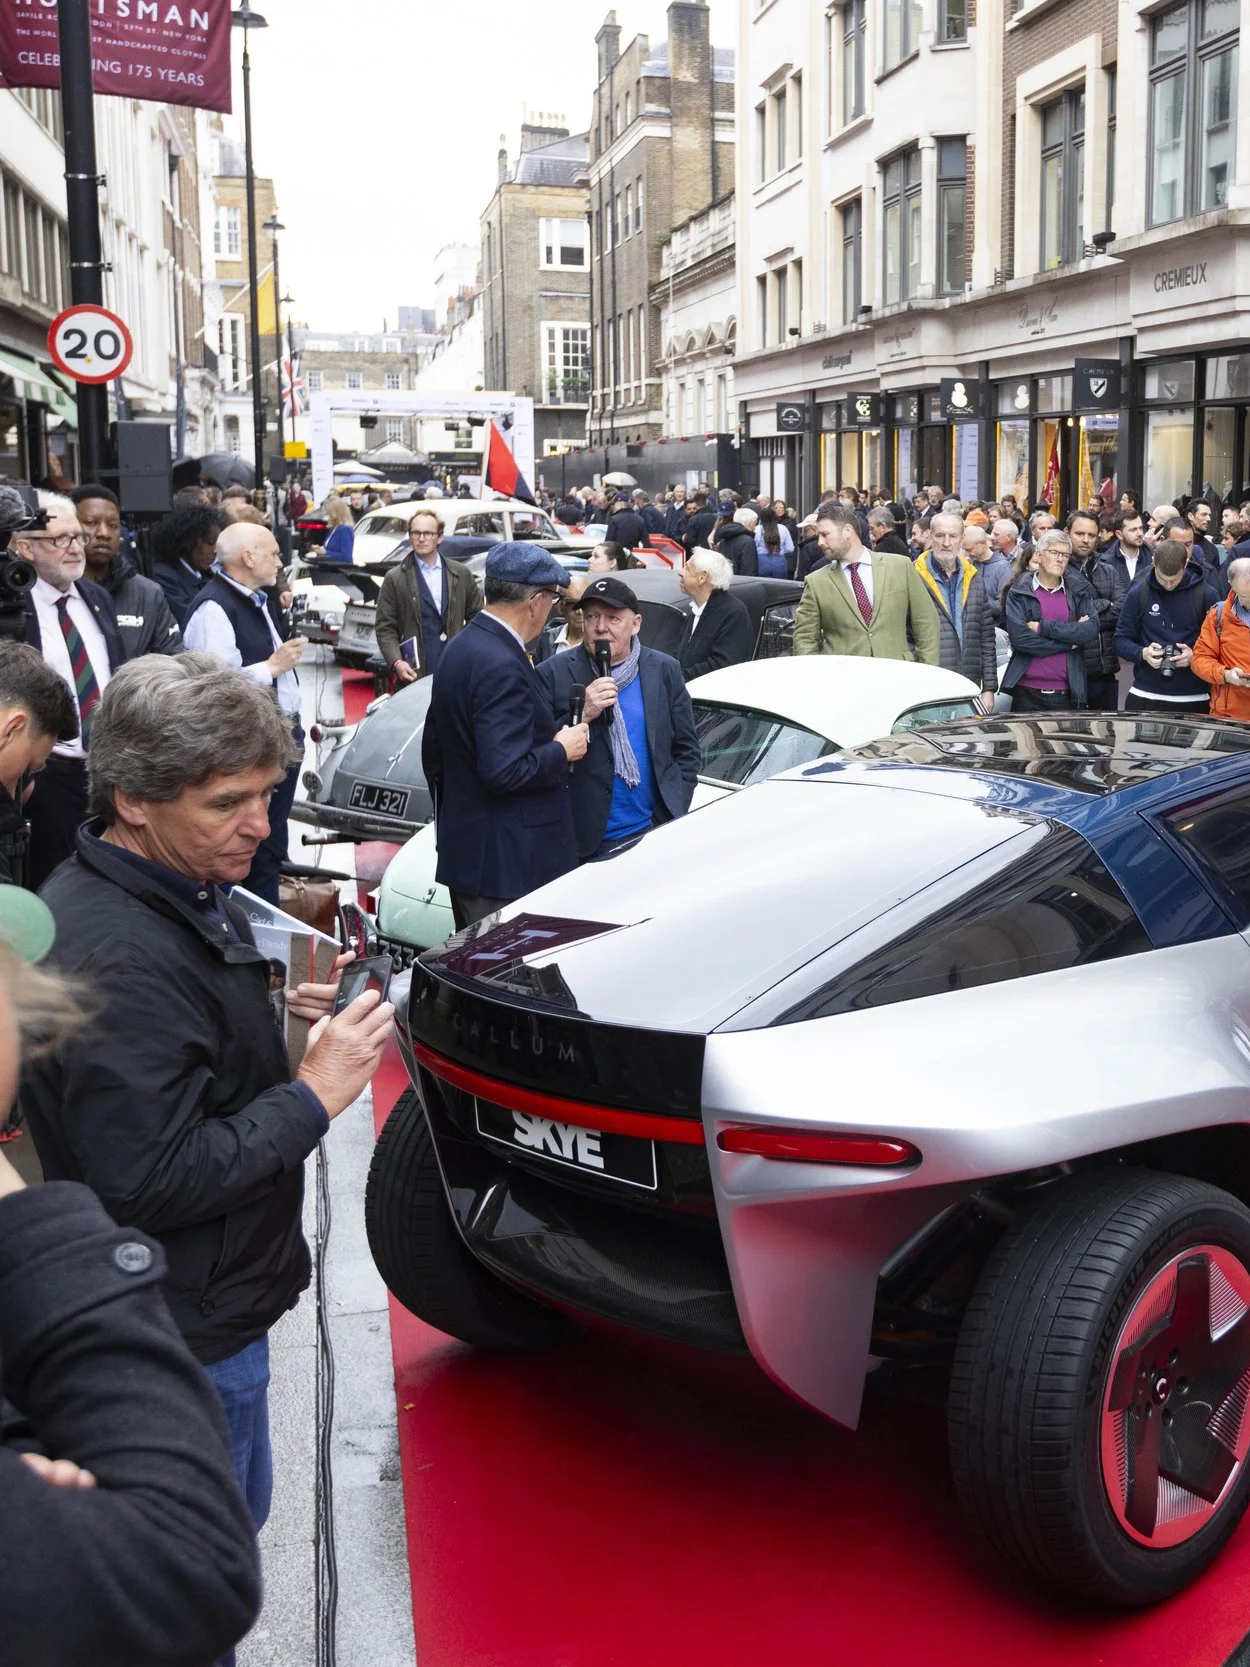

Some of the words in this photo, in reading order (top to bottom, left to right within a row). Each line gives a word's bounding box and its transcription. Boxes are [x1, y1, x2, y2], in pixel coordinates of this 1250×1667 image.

[105, 38, 168, 54] HANDCRAFTED
[171, 47, 207, 60] CLOTHES
[18, 51, 122, 74] CELEBING
[128, 63, 153, 79] 175
[158, 67, 205, 87] YEARS
[1153, 261, 1208, 294] CREMIEUX
[63, 327, 121, 361] 20
[305, 772, 320, 790] GB
[351, 784, 380, 808] FLJ
[380, 790, 406, 815] 321
[453, 1012, 575, 1062] CALLUM
[511, 1109, 604, 1169] SKYE
